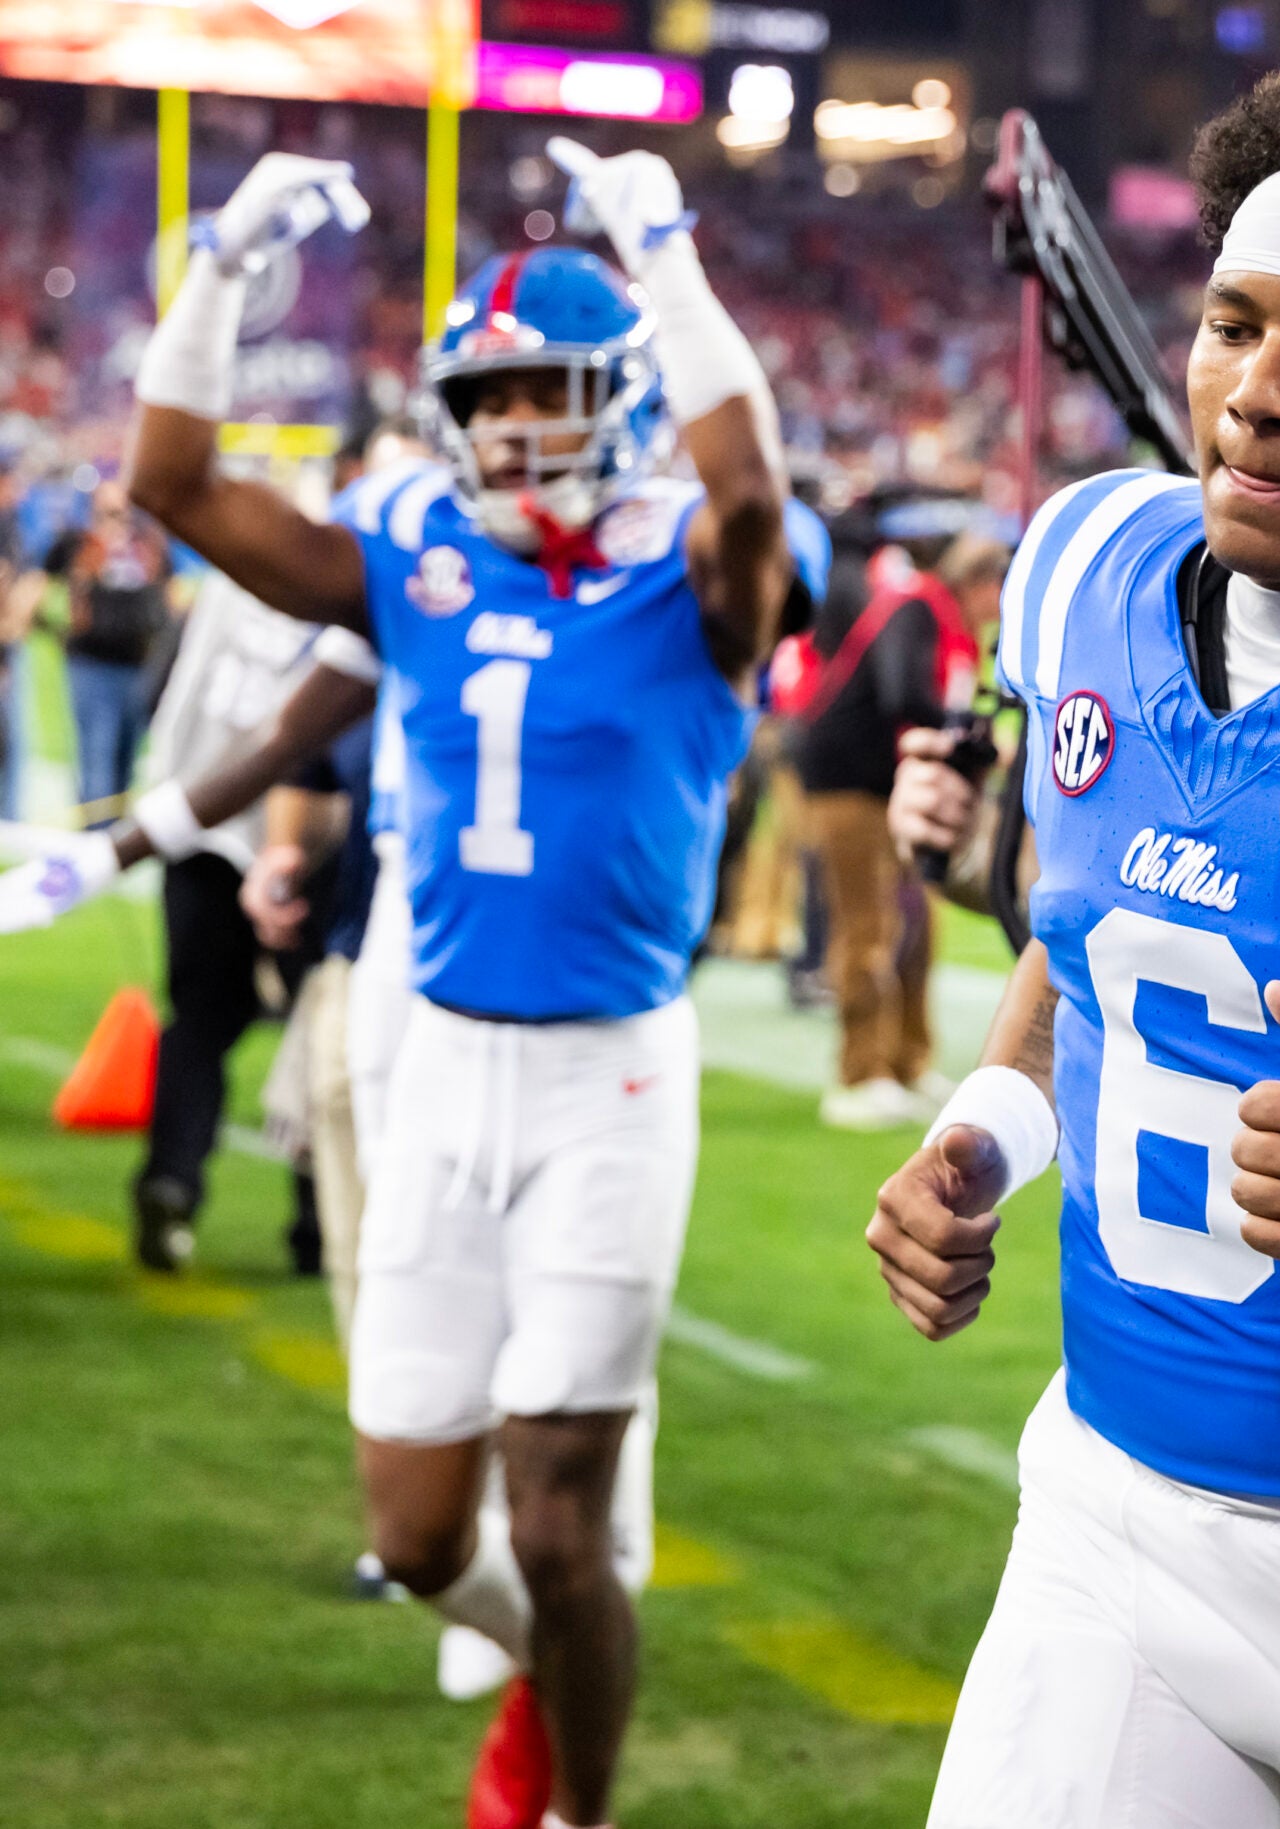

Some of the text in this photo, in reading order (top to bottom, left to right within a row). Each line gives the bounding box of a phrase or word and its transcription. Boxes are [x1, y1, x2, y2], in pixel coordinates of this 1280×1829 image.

[459, 659, 534, 876] 1
[1054, 697, 1108, 788] SEC
[1120, 827, 1240, 912] Ole Miss
[1086, 907, 1275, 1304] 6
